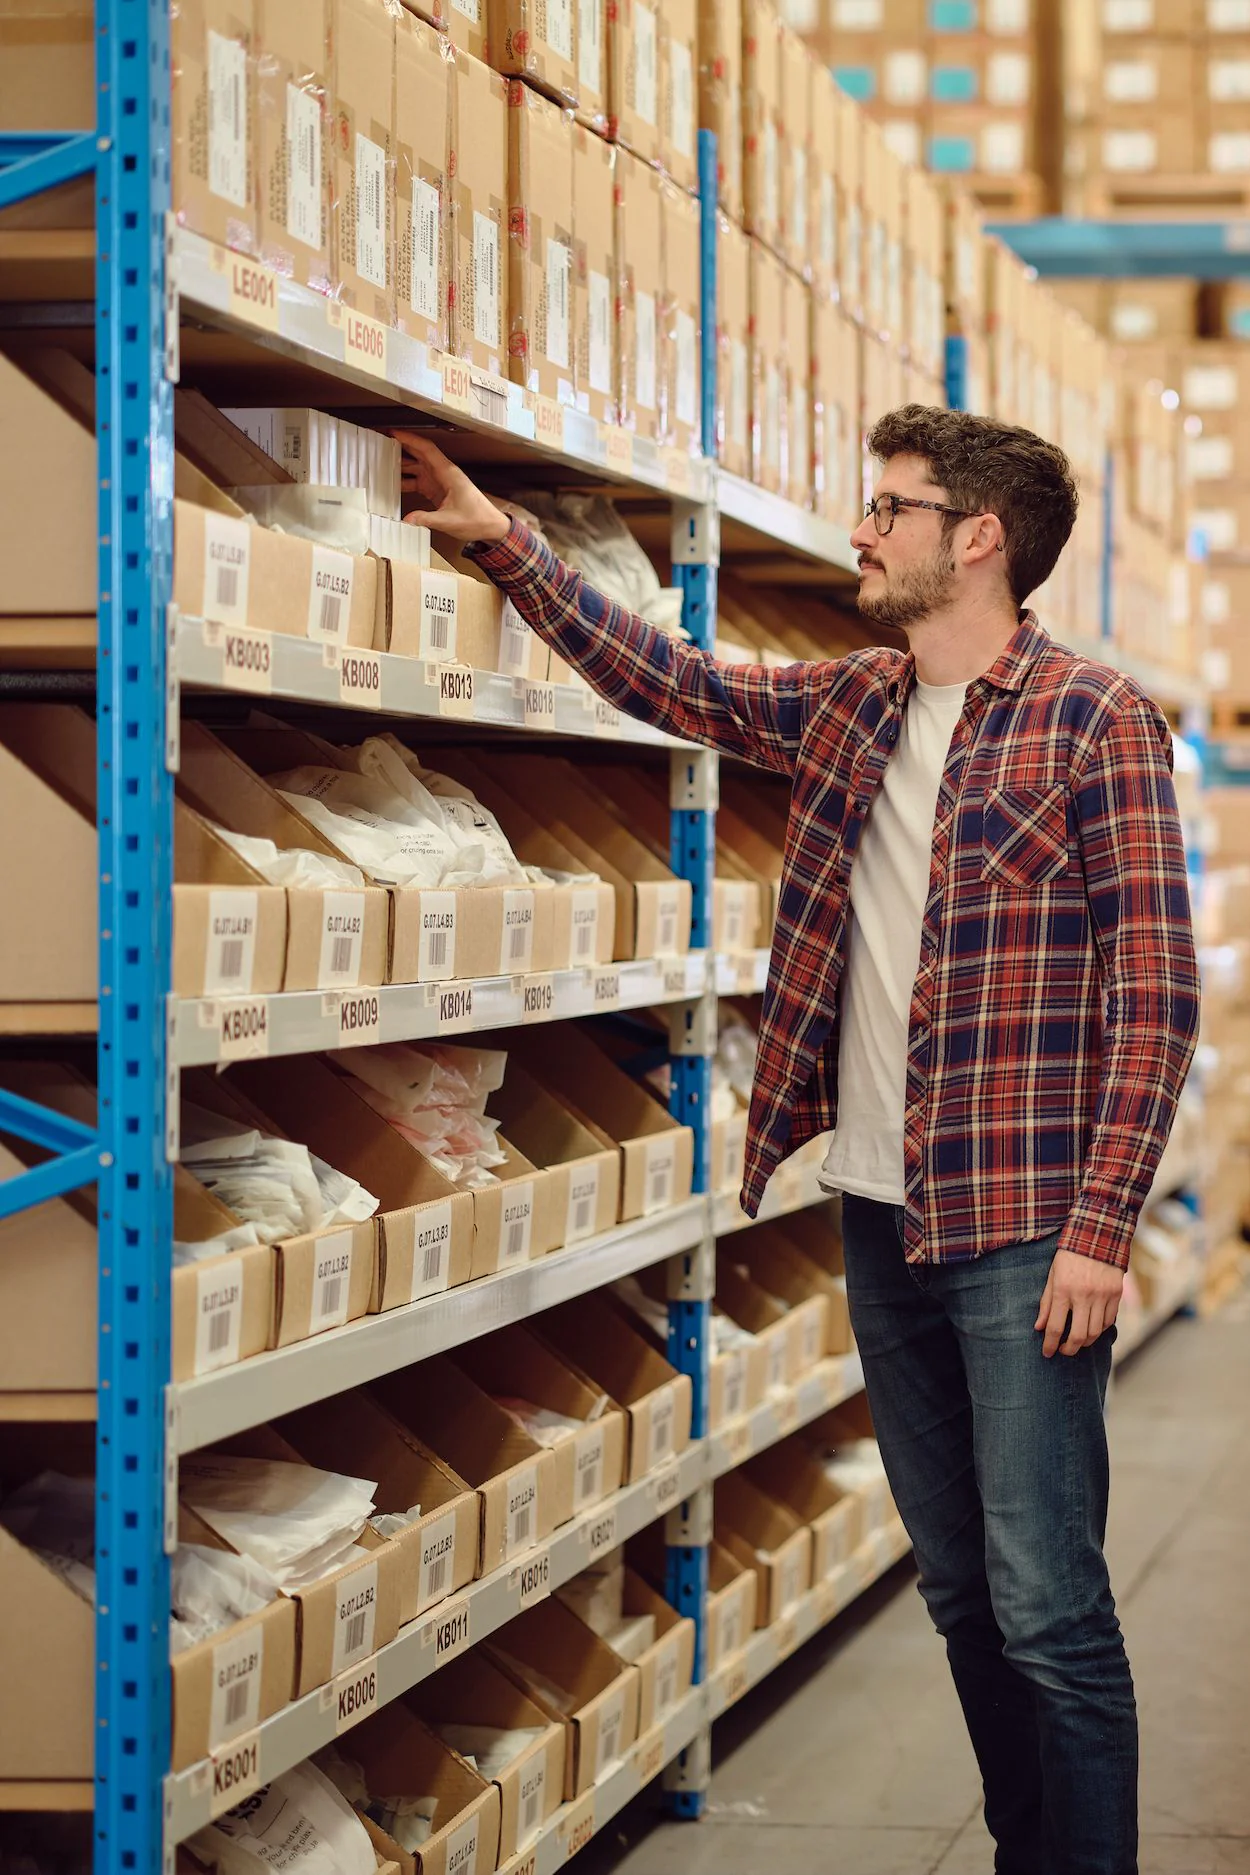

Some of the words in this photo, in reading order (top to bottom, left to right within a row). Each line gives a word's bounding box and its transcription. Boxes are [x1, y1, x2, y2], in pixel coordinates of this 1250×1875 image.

[233, 264, 275, 308] LE001
[347, 317, 384, 359] LE006
[444, 365, 468, 399] LE01
[316, 571, 349, 595] G.07.L5.B2
[425, 594, 455, 614] G.07.L5.B3
[225, 635, 269, 672] KB003
[342, 658, 379, 689] KB008
[440, 672, 472, 699] KB013
[525, 689, 553, 714] KB018
[327, 916, 361, 933] G.07.L4.B2
[424, 914, 453, 928] G.07.L4.B3
[341, 997, 378, 1030] KB009
[440, 990, 472, 1020] KB014
[524, 985, 552, 1011] KB019
[222, 1006, 266, 1042] KB004
[418, 1224, 448, 1249] G.07.L3.B3
[318, 1255, 349, 1279] G.07.L3.B2
[423, 1534, 453, 1565] G.07.L2.B3
[521, 1557, 549, 1596] KB016
[340, 1587, 374, 1620] G.07.L2.B2
[436, 1611, 468, 1655] KB011
[218, 1654, 258, 1688] G.07.L2.B1
[338, 1672, 376, 1720] KB006
[213, 1744, 257, 1796] KB001
[449, 1837, 476, 1871] G.07.L1.B3
